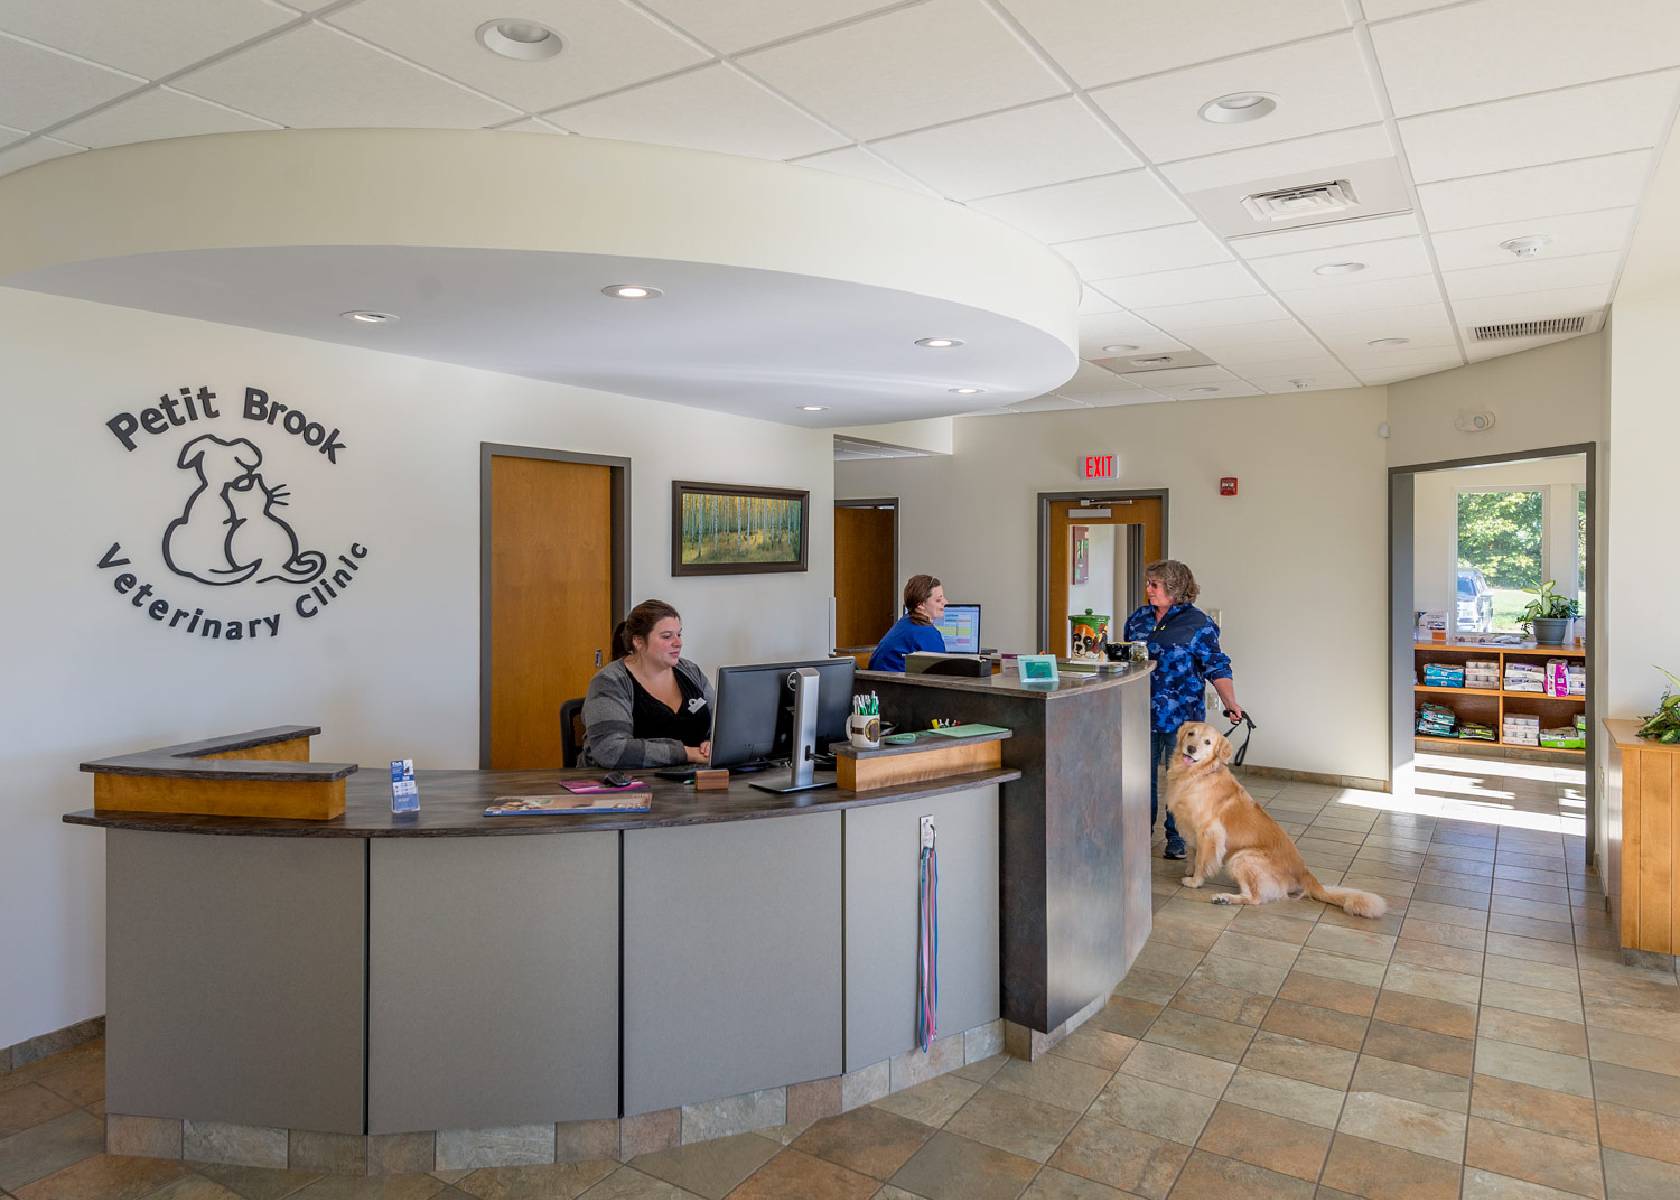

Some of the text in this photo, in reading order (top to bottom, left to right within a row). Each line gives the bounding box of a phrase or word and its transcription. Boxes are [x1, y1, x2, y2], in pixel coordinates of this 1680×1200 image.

[105, 386, 348, 465] Petit Brook
[1085, 455, 1113, 478] EXIT
[96, 541, 368, 641] Veterinary Clinic
